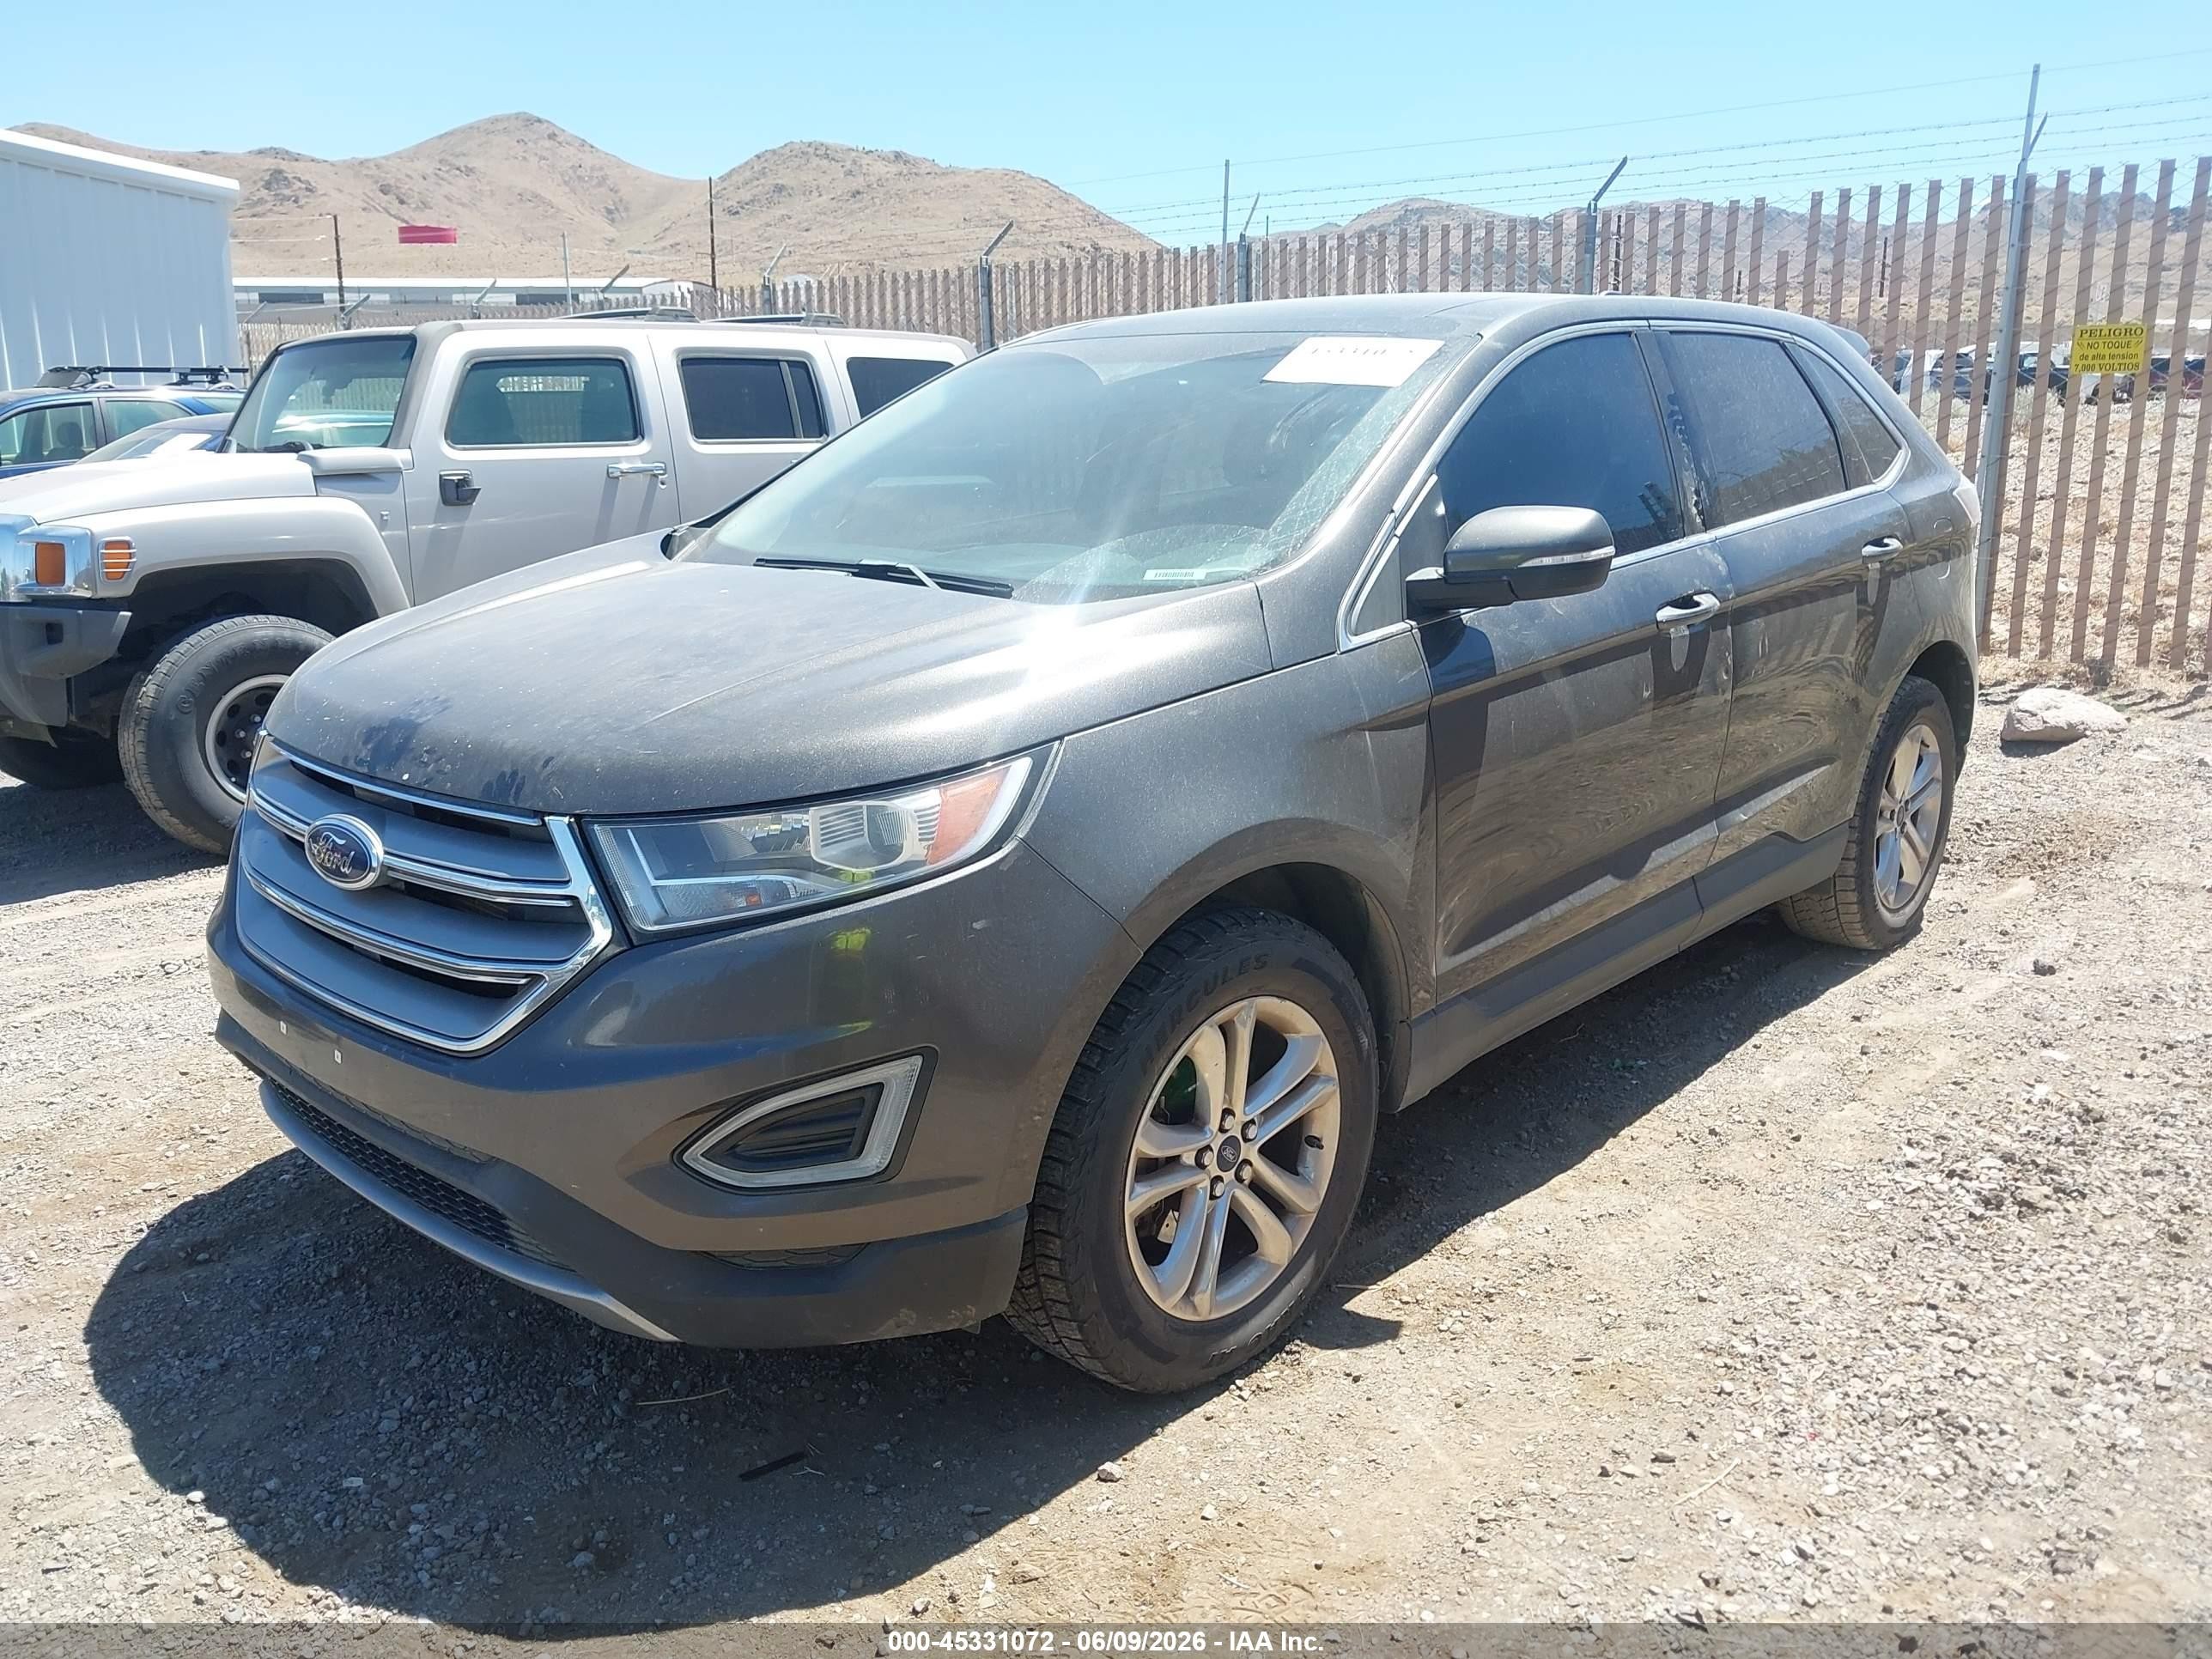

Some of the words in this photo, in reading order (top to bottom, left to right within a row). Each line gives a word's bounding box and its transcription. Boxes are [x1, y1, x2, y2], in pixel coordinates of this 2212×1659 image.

[2079, 326, 2144, 337] PELIGRO
[2087, 342, 2100, 350] NO
[2102, 340, 2132, 349] TOQUE
[2079, 352, 2089, 361] de
[2091, 352, 2106, 361] alta
[2075, 363, 2096, 373] 7,000
[2099, 362, 2140, 372] VOLTIOS
[309, 831, 356, 874] Ford
